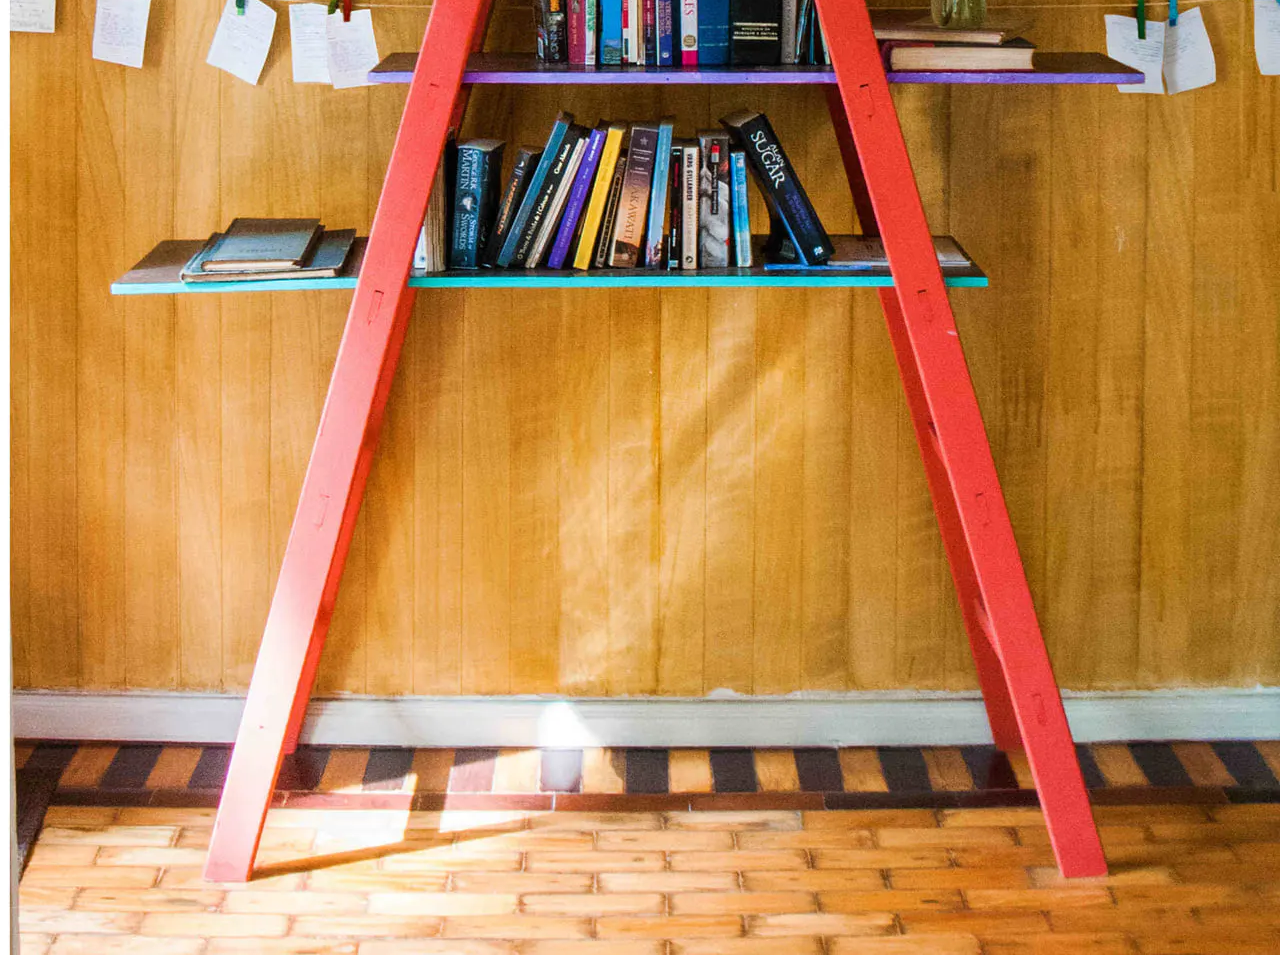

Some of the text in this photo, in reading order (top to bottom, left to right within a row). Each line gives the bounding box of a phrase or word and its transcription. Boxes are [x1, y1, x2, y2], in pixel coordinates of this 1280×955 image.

[460, 149, 472, 189] MARTIN
[750, 130, 786, 189] SUGAR
[770, 143, 786, 168] ALAN
[459, 213, 469, 250] SWORDS
